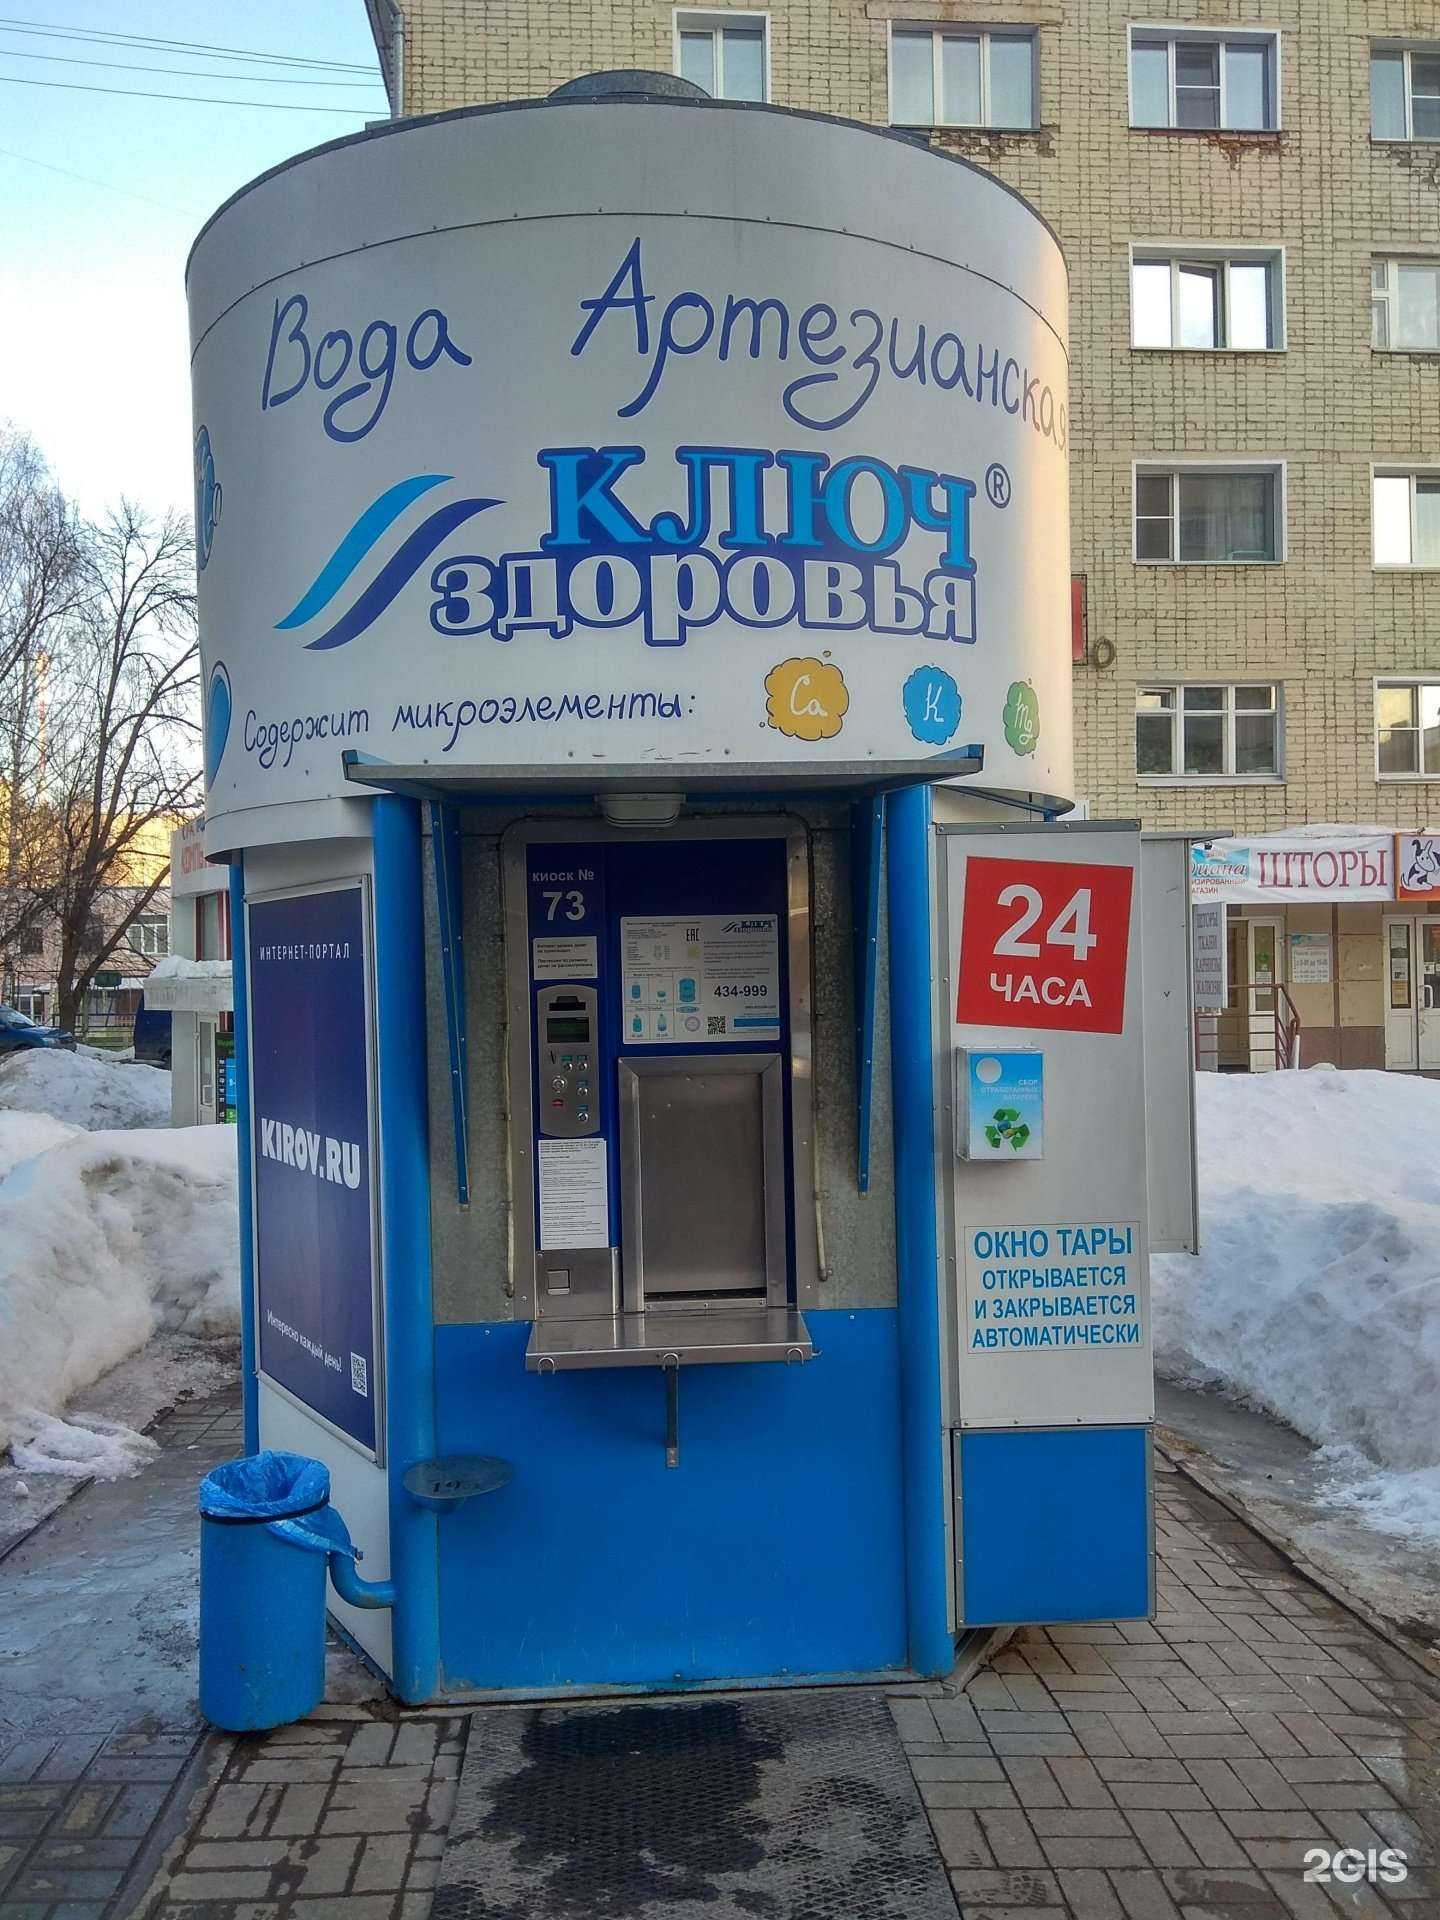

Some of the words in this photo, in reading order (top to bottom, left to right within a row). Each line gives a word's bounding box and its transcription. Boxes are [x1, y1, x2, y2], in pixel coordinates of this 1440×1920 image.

[262, 294, 472, 443] Вода
[570, 237, 1067, 459] Артезианская
[244, 708, 369, 769] Содержит
[392, 692, 697, 752] микроэлементы:
[578, 868, 595, 881] №
[1257, 849, 1388, 889] ШТОРЫ
[542, 890, 586, 921] 73
[992, 883, 1098, 961] 24
[259, 942, 350, 961] ИНТЕРНЕТ-ПОРТАЛ
[714, 984, 768, 998] 434-999
[989, 972, 1093, 1008] ЧАСА
[261, 1117, 361, 1190] KIROV.RU
[973, 1229, 1049, 1259] ОКНО
[1056, 1227, 1132, 1256] ТАРЫ
[982, 1265, 1126, 1290] ОТКРЫВАЕТСЯ
[975, 1299, 987, 1320] И
[993, 1294, 1136, 1319] ЗАКРЫВАЕТСЯ
[267, 1309, 298, 1343] Интересно
[972, 1323, 1139, 1349] АВТОМАТИЧЕСКИ
